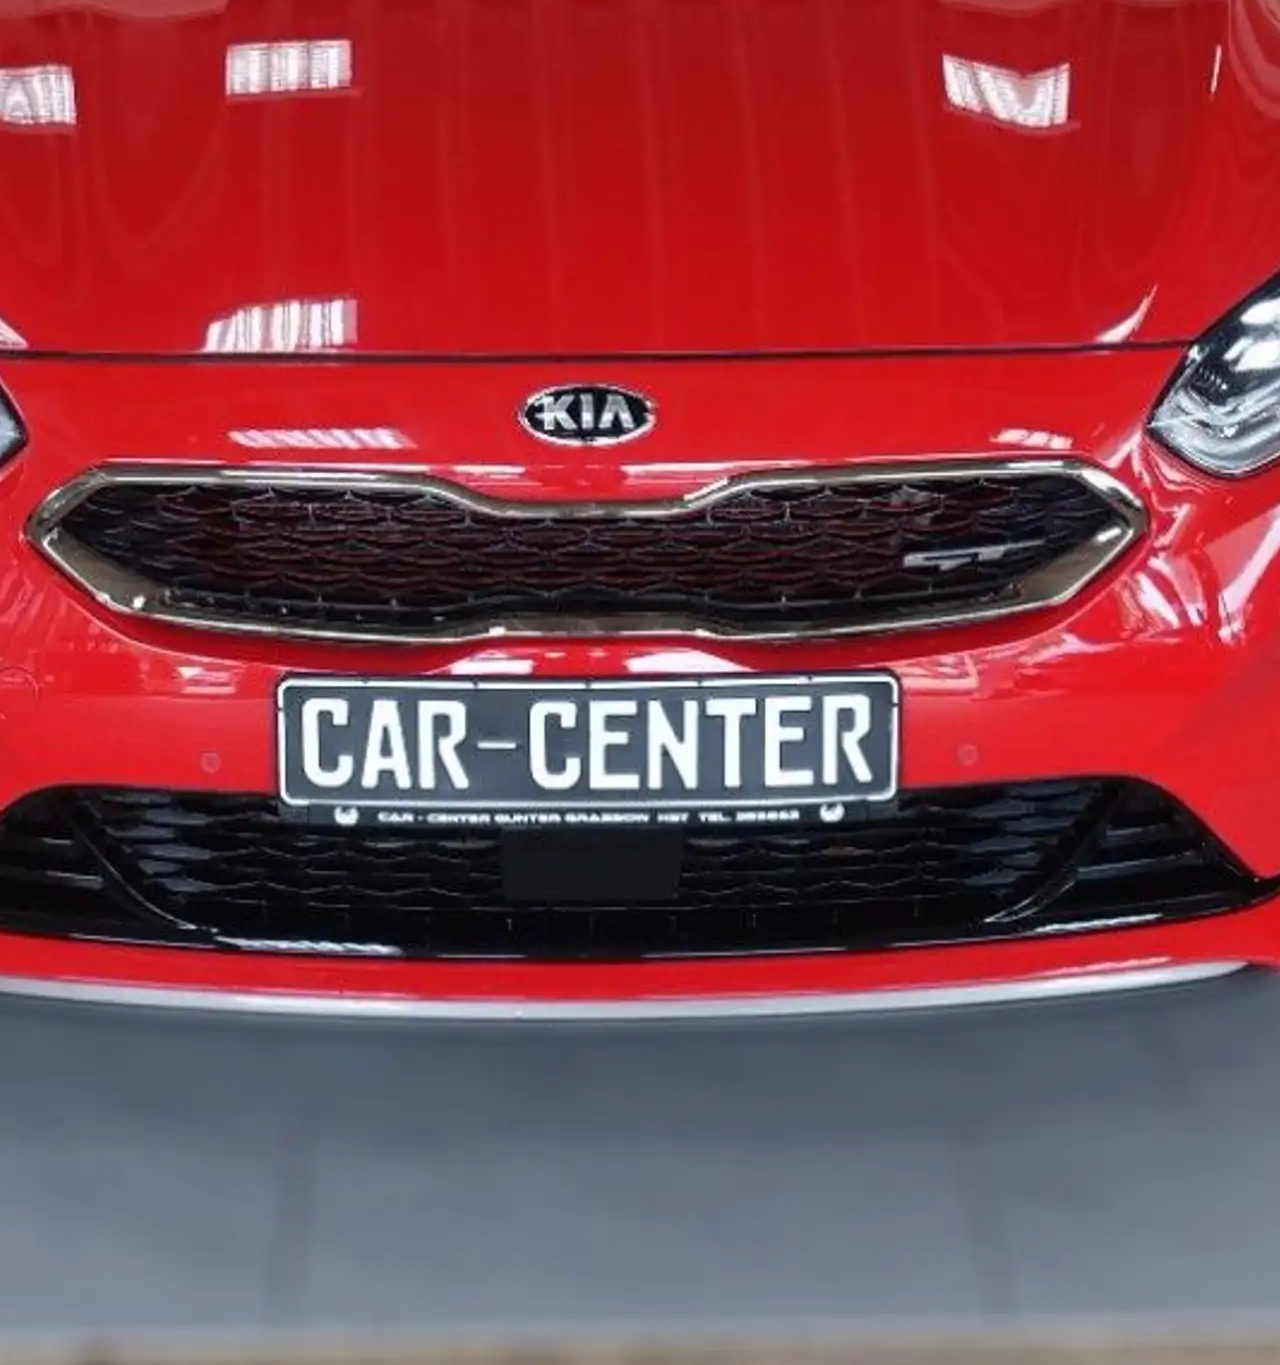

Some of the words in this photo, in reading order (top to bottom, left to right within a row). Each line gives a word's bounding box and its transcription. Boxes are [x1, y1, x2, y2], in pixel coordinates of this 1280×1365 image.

[535, 393, 635, 430] KIA
[301, 693, 872, 790] CAR-CENTER
[377, 810, 414, 824] CAR
[426, 811, 490, 824] CENTER
